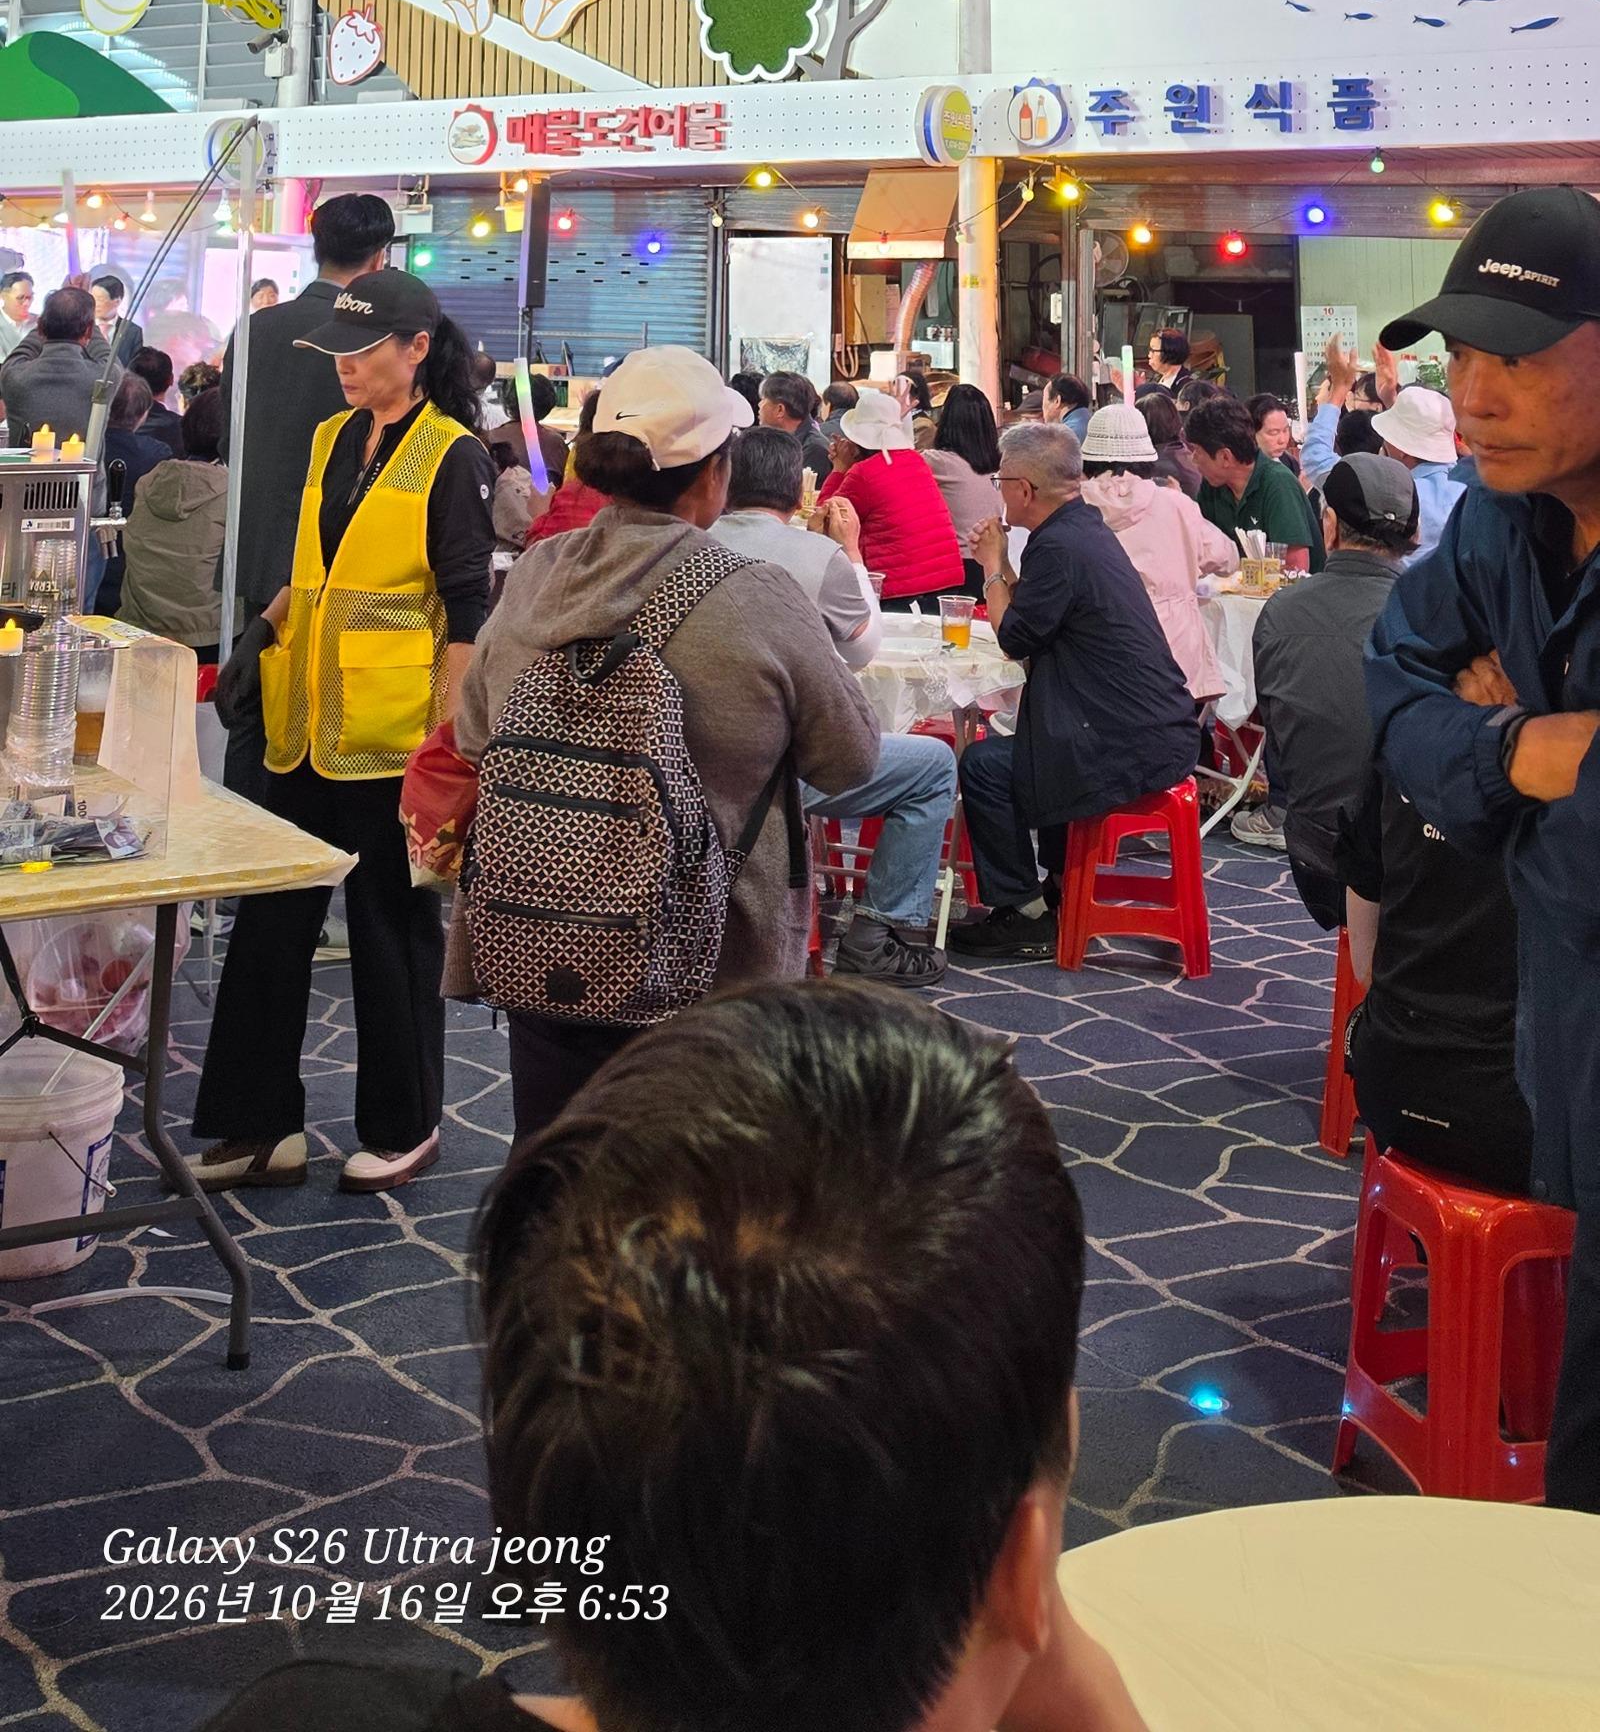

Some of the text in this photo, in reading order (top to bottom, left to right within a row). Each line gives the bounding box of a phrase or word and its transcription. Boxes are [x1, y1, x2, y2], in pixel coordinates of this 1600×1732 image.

[506, 103, 732, 156] 매물도건어물
[1478, 258, 1523, 279] Jeep
[1323, 307, 1335, 316] 10
[29, 579, 60, 592] TERRA
